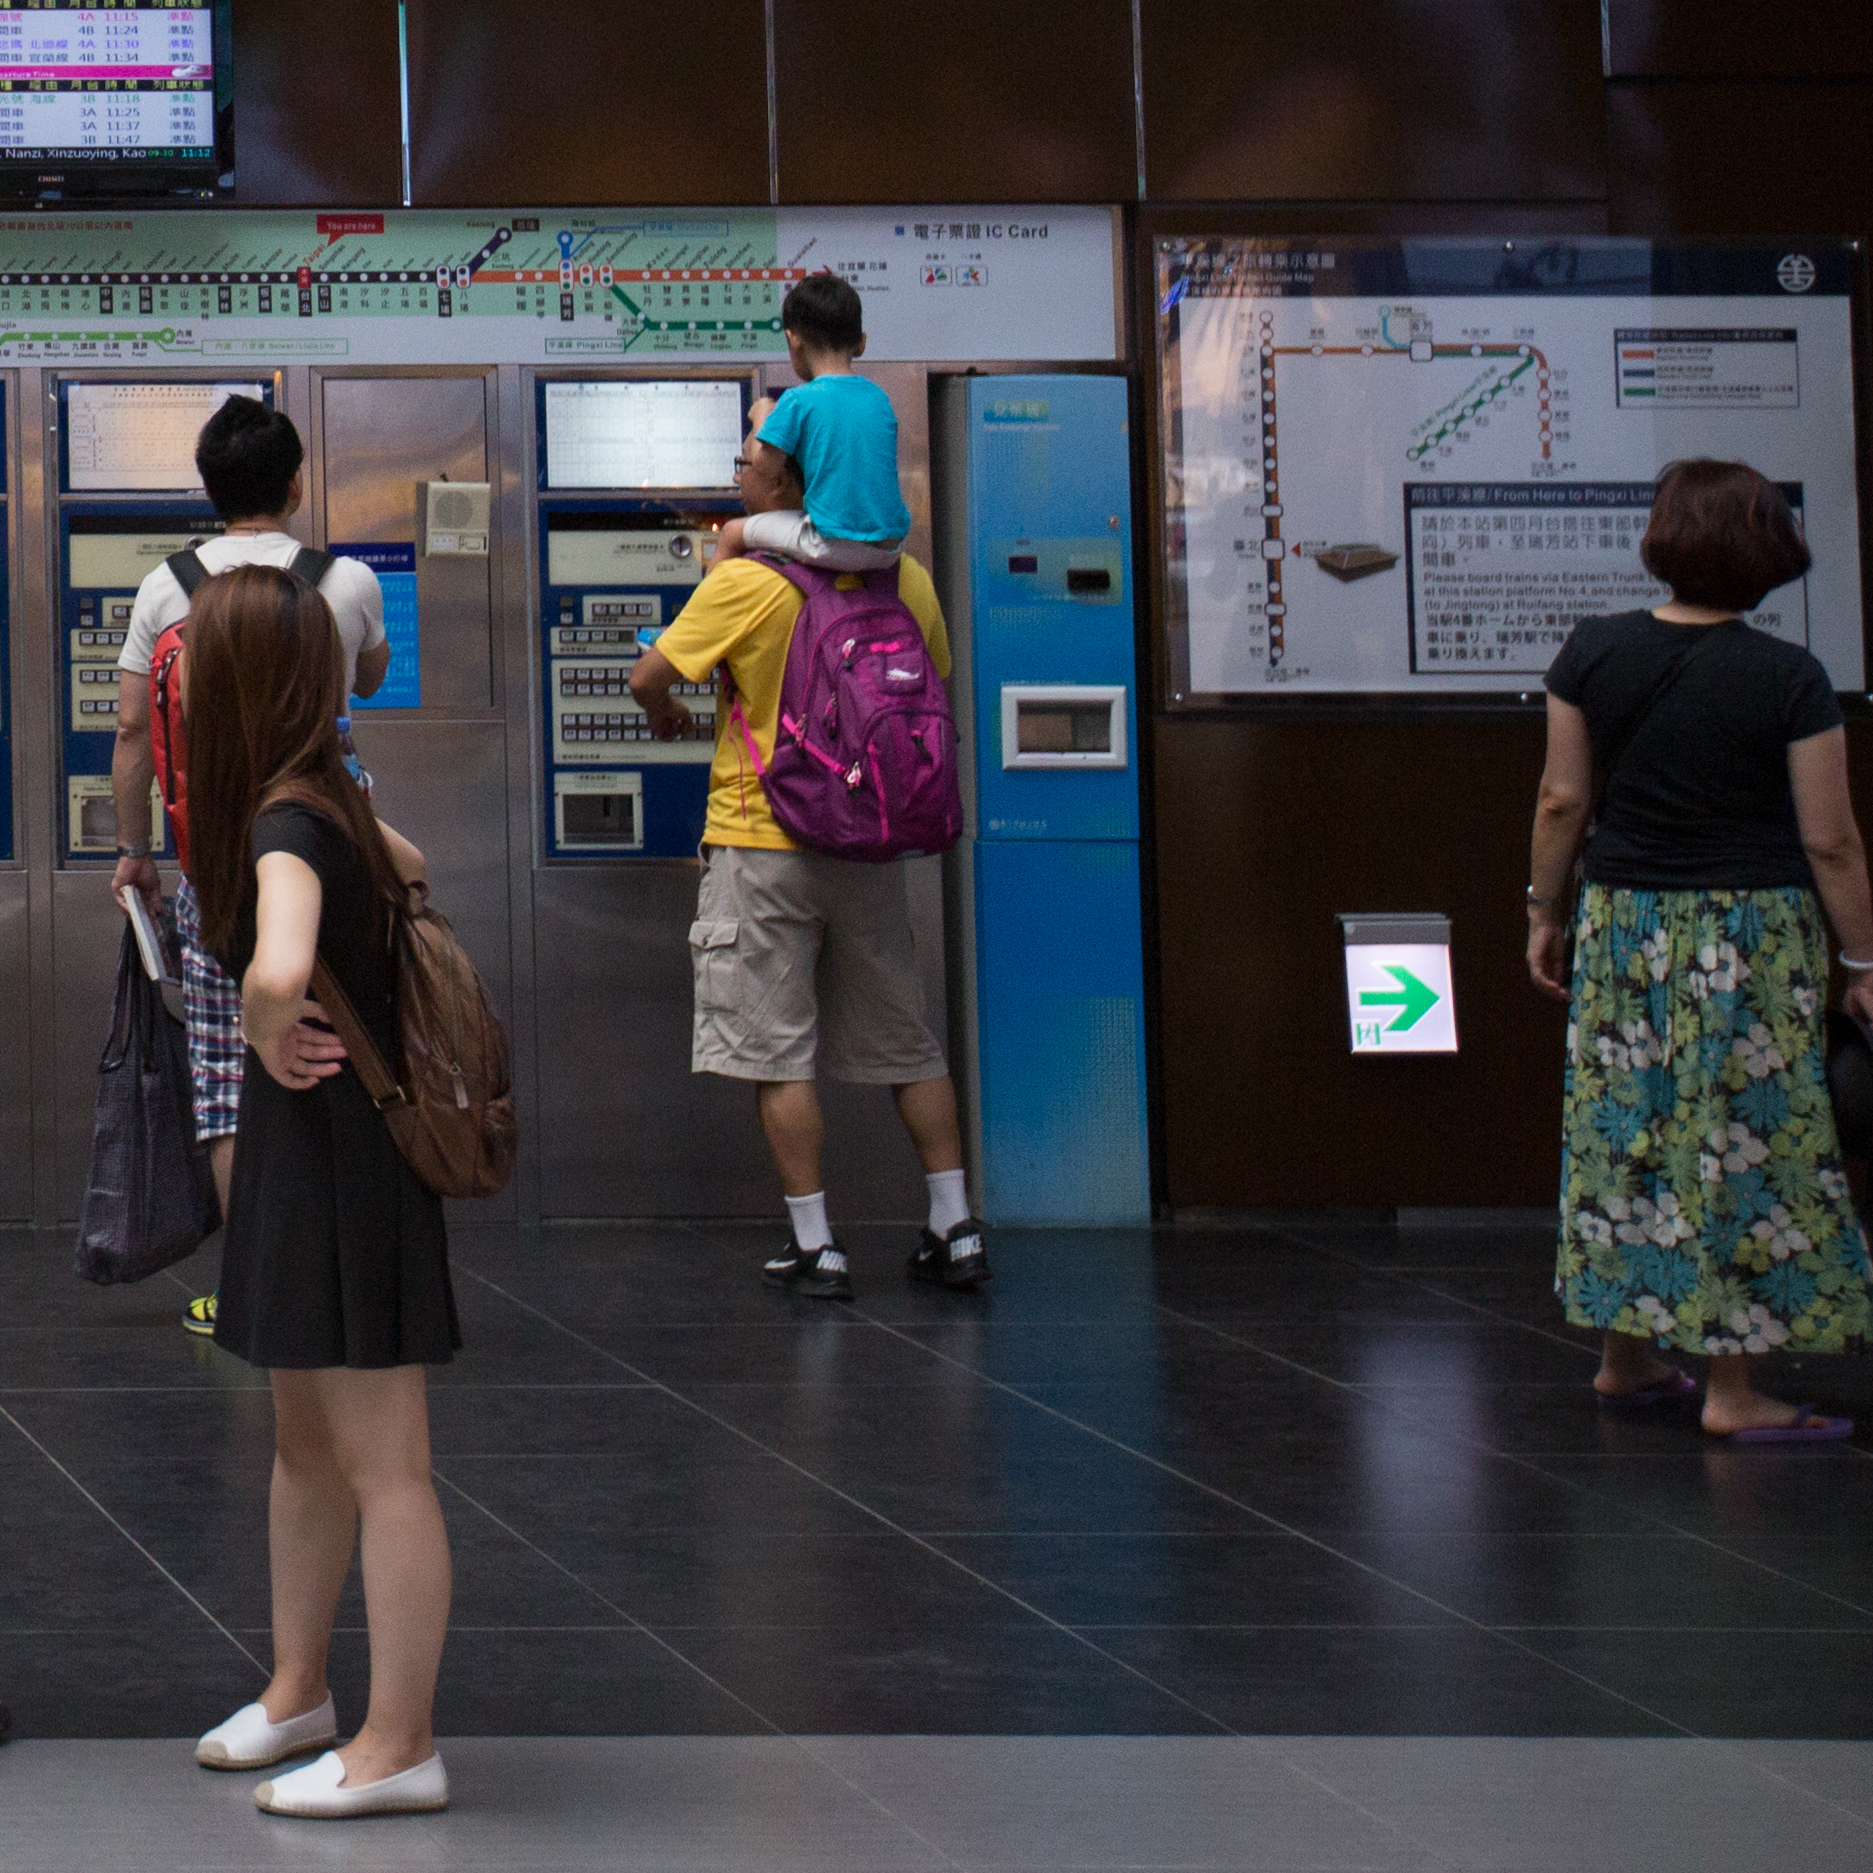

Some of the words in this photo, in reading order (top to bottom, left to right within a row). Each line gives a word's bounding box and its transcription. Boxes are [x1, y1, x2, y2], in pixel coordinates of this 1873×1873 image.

[6, 149, 44, 160] Nanzi,
[123, 149, 146, 158] Kao
[182, 149, 211, 157] 11:12
[914, 224, 982, 240] 電子票證
[986, 226, 1003, 239] IC
[1009, 225, 1048, 239] Card
[1533, 489, 1564, 502] Here
[1569, 489, 1582, 502] to
[1585, 488, 1627, 504] Pingxi
